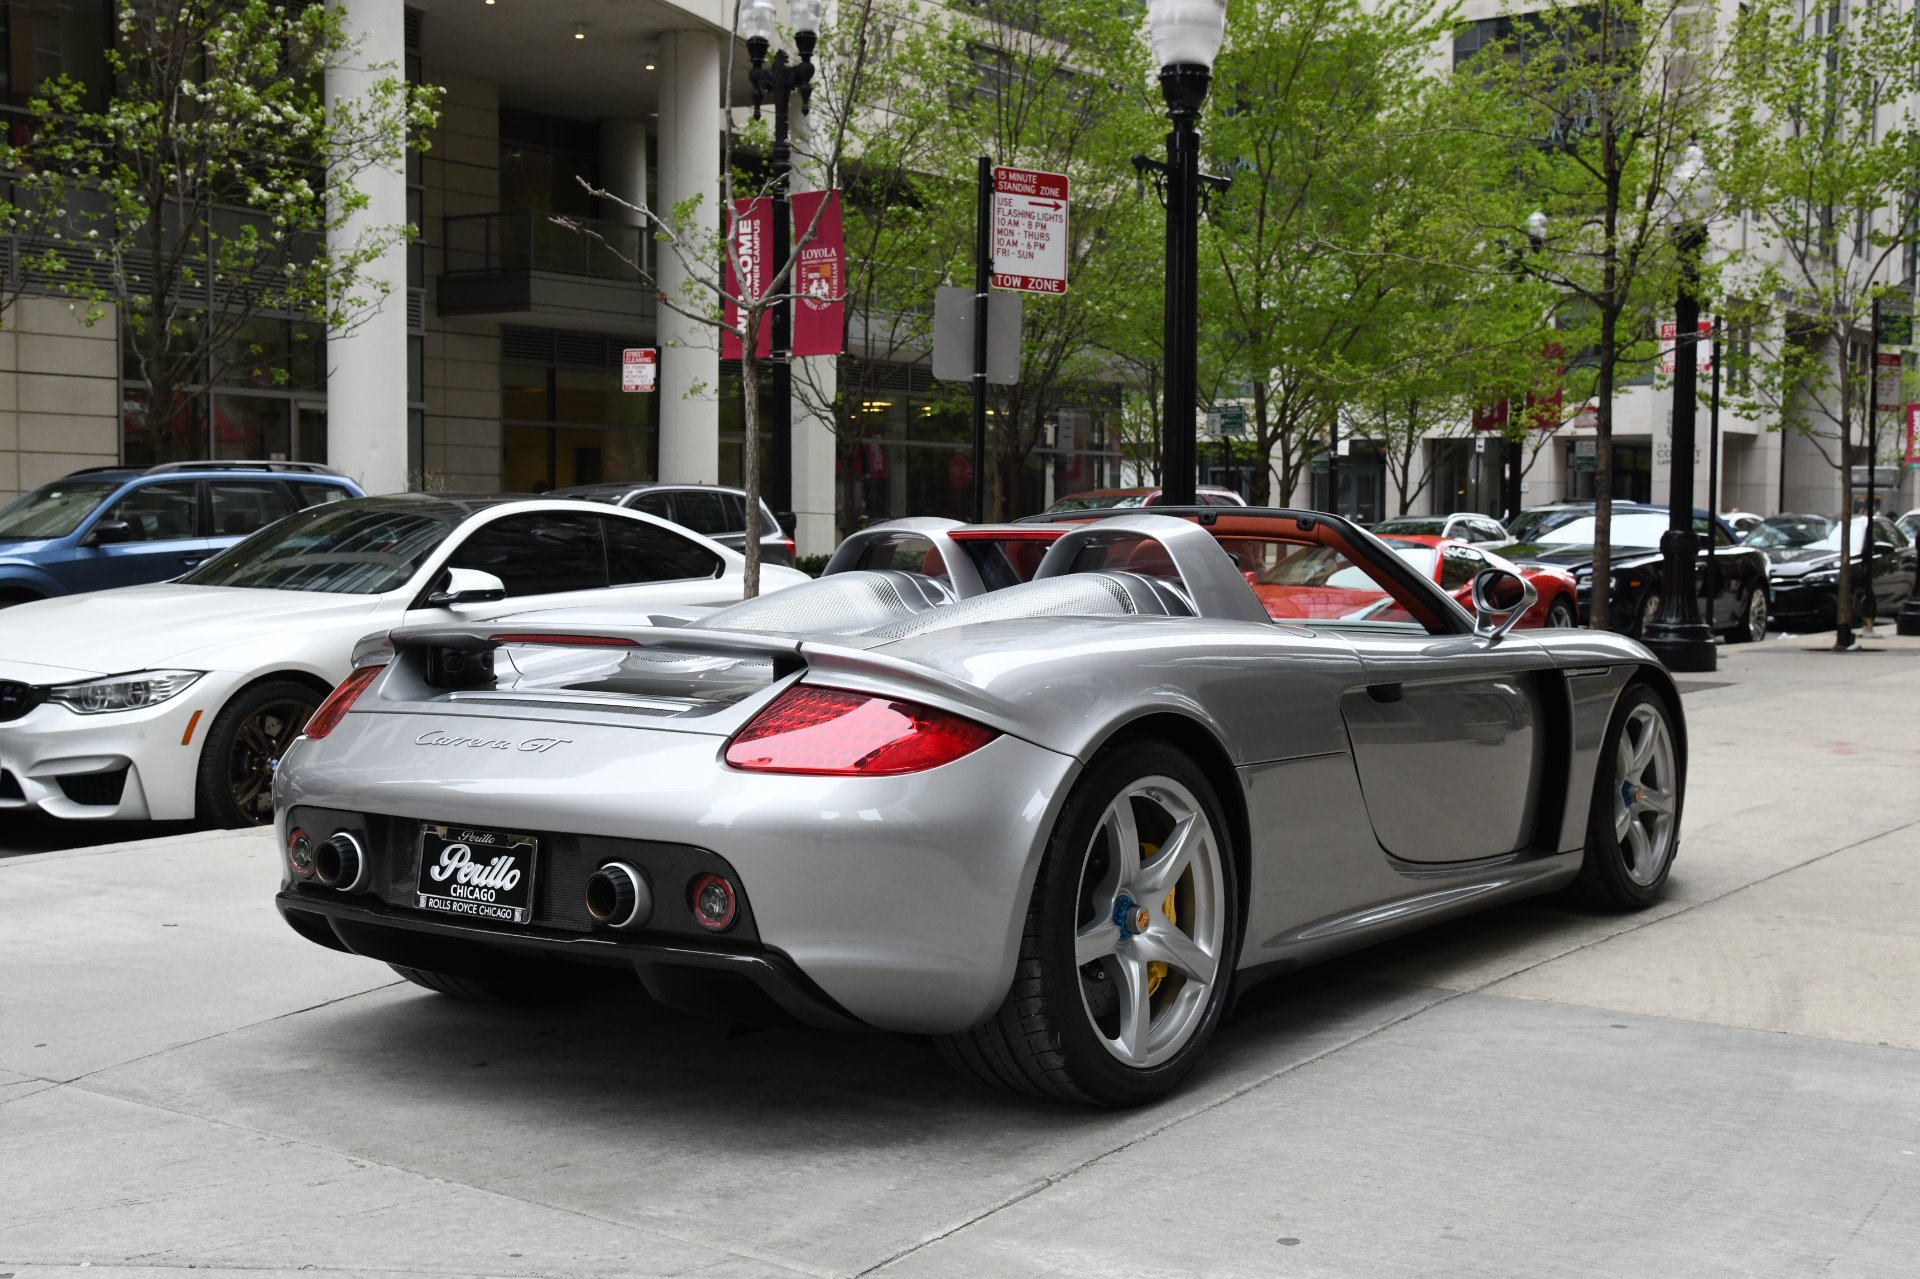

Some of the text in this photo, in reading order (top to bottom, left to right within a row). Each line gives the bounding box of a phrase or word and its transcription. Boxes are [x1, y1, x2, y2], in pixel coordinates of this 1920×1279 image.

[998, 171, 1037, 184] 15 MINUTE
[998, 181, 1060, 197] STANDING ZONE
[998, 197, 1013, 207] USE
[997, 207, 1064, 224] FLASHING LIGHTS
[997, 217, 1005, 226] 10
[1006, 218, 1019, 228] AM
[1027, 221, 1033, 229] 8
[1035, 222, 1047, 231] PM
[997, 228, 1015, 237] MON
[1024, 230, 1050, 241] THURS
[996, 237, 1005, 246] 10
[1005, 238, 1018, 248] AM
[1027, 241, 1033, 249] 6
[1034, 242, 1045, 251] PM
[753, 219, 761, 300] TOWER CAMPUS
[801, 247, 837, 260] LOYOLA
[996, 247, 1010, 257] FRI
[1017, 250, 1034, 260] SUN
[996, 274, 1060, 292] TOW ZONE
[414, 730, 574, 753] Carrera GT
[457, 830, 496, 844] Perillo
[430, 843, 521, 891] Perillo
[450, 884, 496, 902] CHICAGO
[428, 897, 512, 919] ROLLS ROYCE CHICAGO
